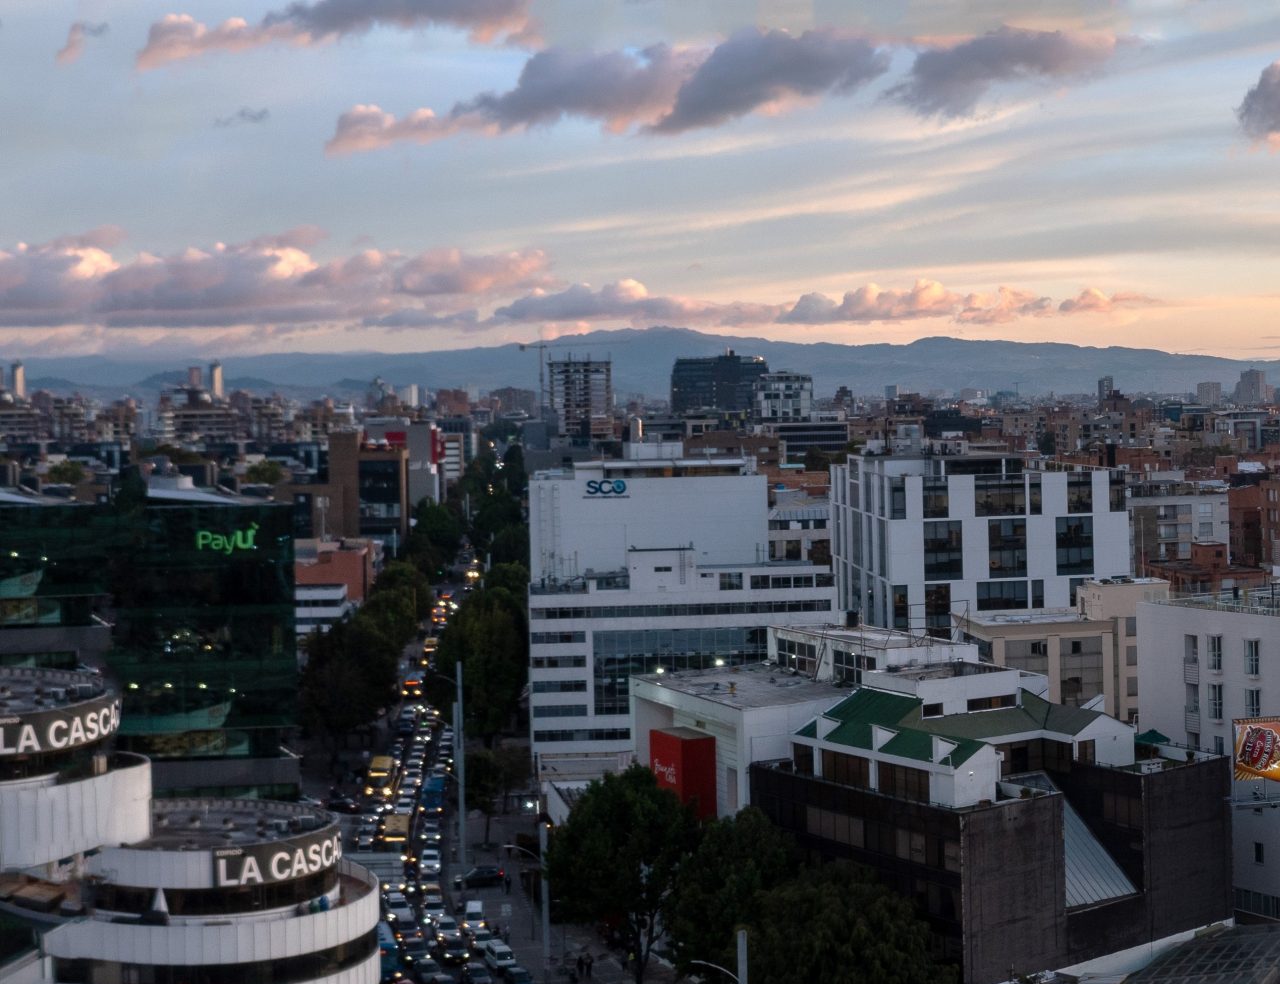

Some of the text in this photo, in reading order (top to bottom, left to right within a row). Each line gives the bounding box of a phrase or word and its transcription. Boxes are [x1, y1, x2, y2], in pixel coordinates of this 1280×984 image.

[586, 480, 627, 495] SCO
[196, 523, 259, 556] PayU
[0, 699, 120, 754] LA CASCA
[217, 833, 342, 887] LA CASCA
